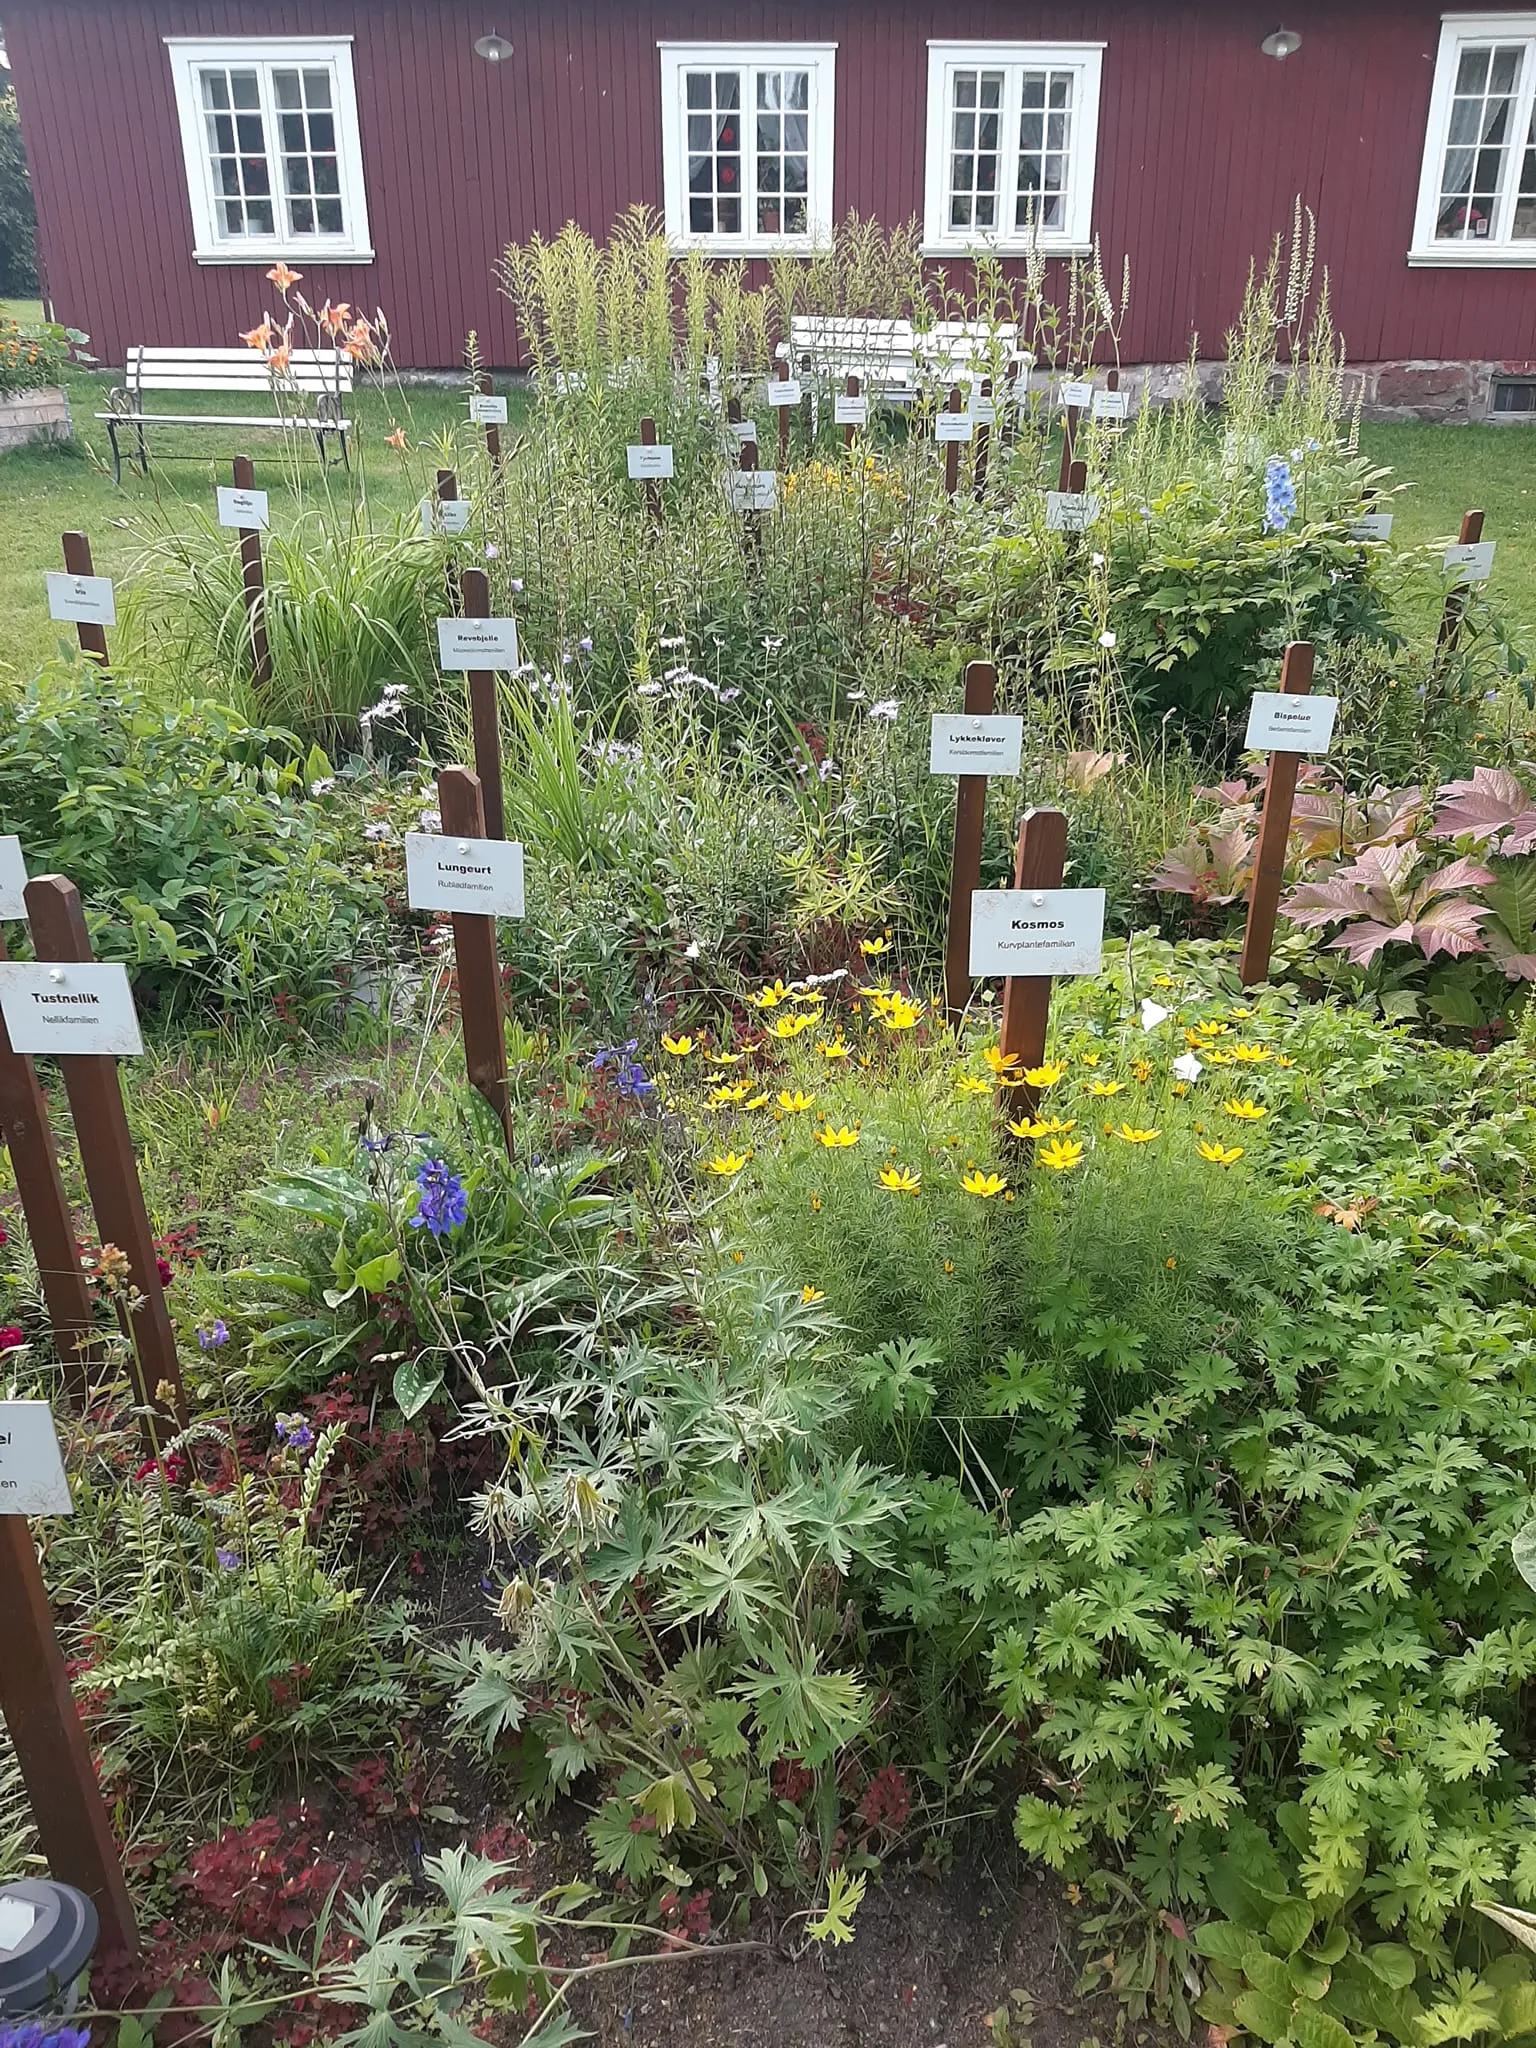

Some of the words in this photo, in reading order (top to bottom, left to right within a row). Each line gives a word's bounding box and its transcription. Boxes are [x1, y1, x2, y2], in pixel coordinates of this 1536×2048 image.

[437, 861, 492, 875] Lungeurt
[1011, 919, 1065, 930] Kosmos
[997, 940, 1076, 951] Kurvplantefamilien
[31, 992, 100, 1004] Tustnellik
[42, 1015, 100, 1025] Nellikfamilien
